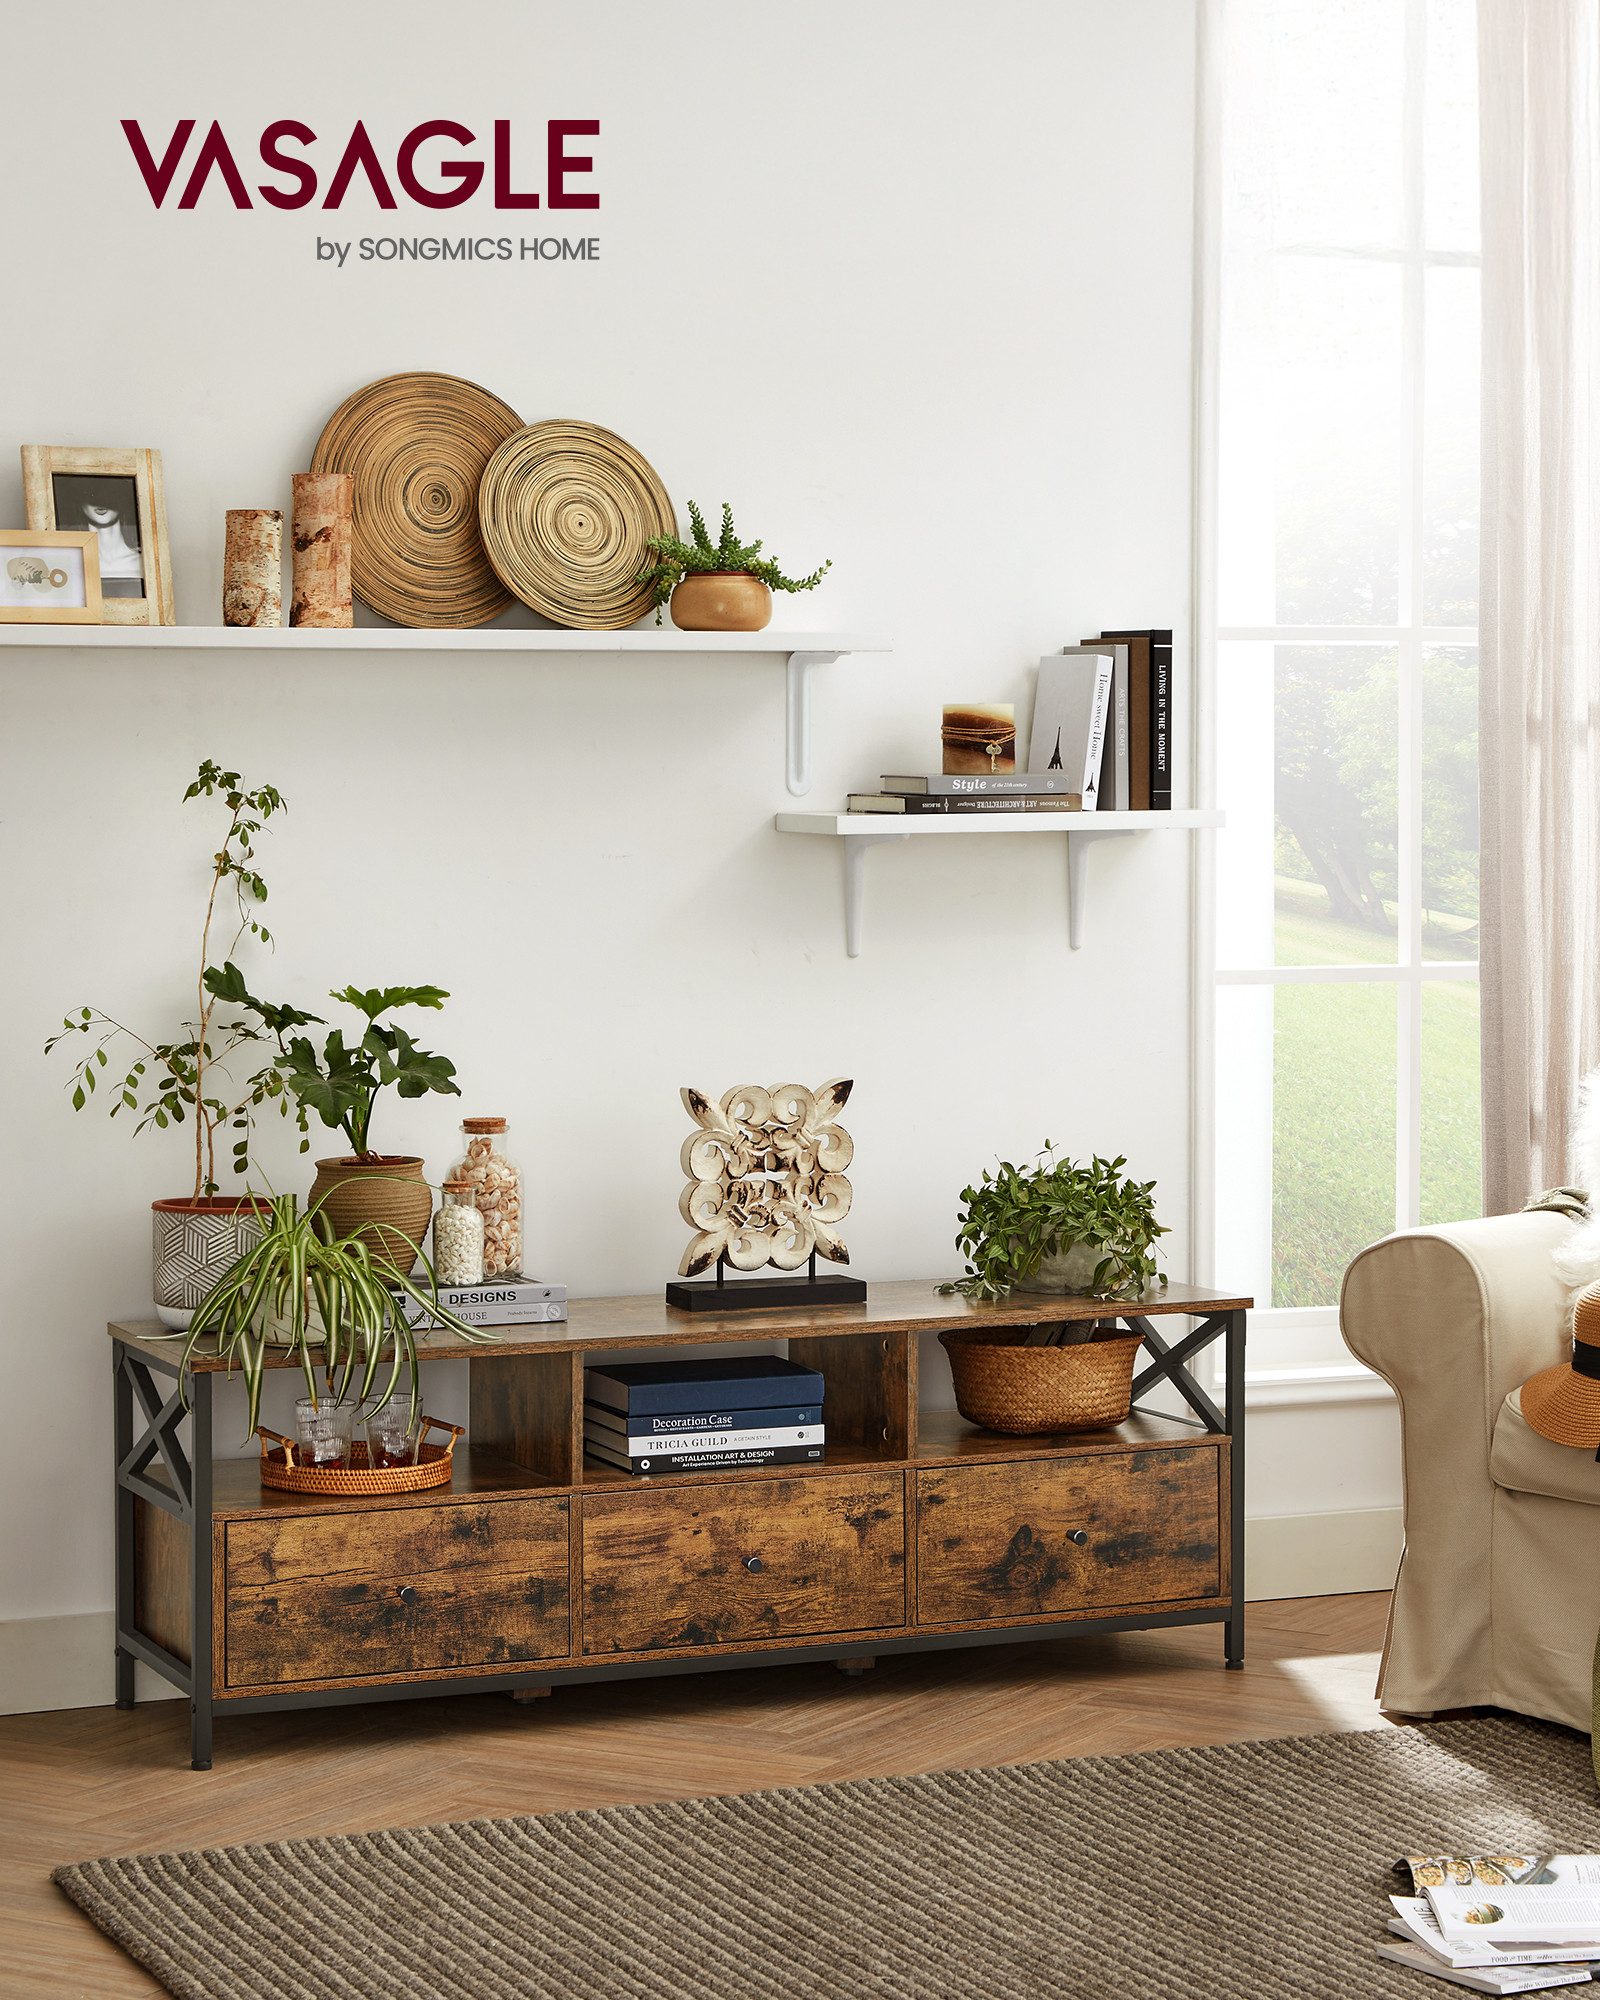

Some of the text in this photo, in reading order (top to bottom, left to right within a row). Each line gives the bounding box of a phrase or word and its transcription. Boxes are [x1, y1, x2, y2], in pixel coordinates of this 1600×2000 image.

[1090, 673, 1108, 760] Home sweet Home
[1118, 687, 1126, 757] ARTS THE CRAFTS
[1158, 665, 1166, 772] LIVING IN THE MOMENT
[952, 779, 987, 792] Style
[977, 800, 1021, 808] ARCHITECTURE
[1025, 800, 1038, 808] ART
[449, 1291, 517, 1305] DESIGNS
[652, 1416, 707, 1429] Decoration
[708, 1414, 733, 1425] Case
[647, 1440, 688, 1450] TRICIA
[691, 1437, 728, 1447] GUILD
[671, 1453, 723, 1463] INSTALLATION
[724, 1452, 739, 1460] ART
[747, 1450, 775, 1458] DESIGN
